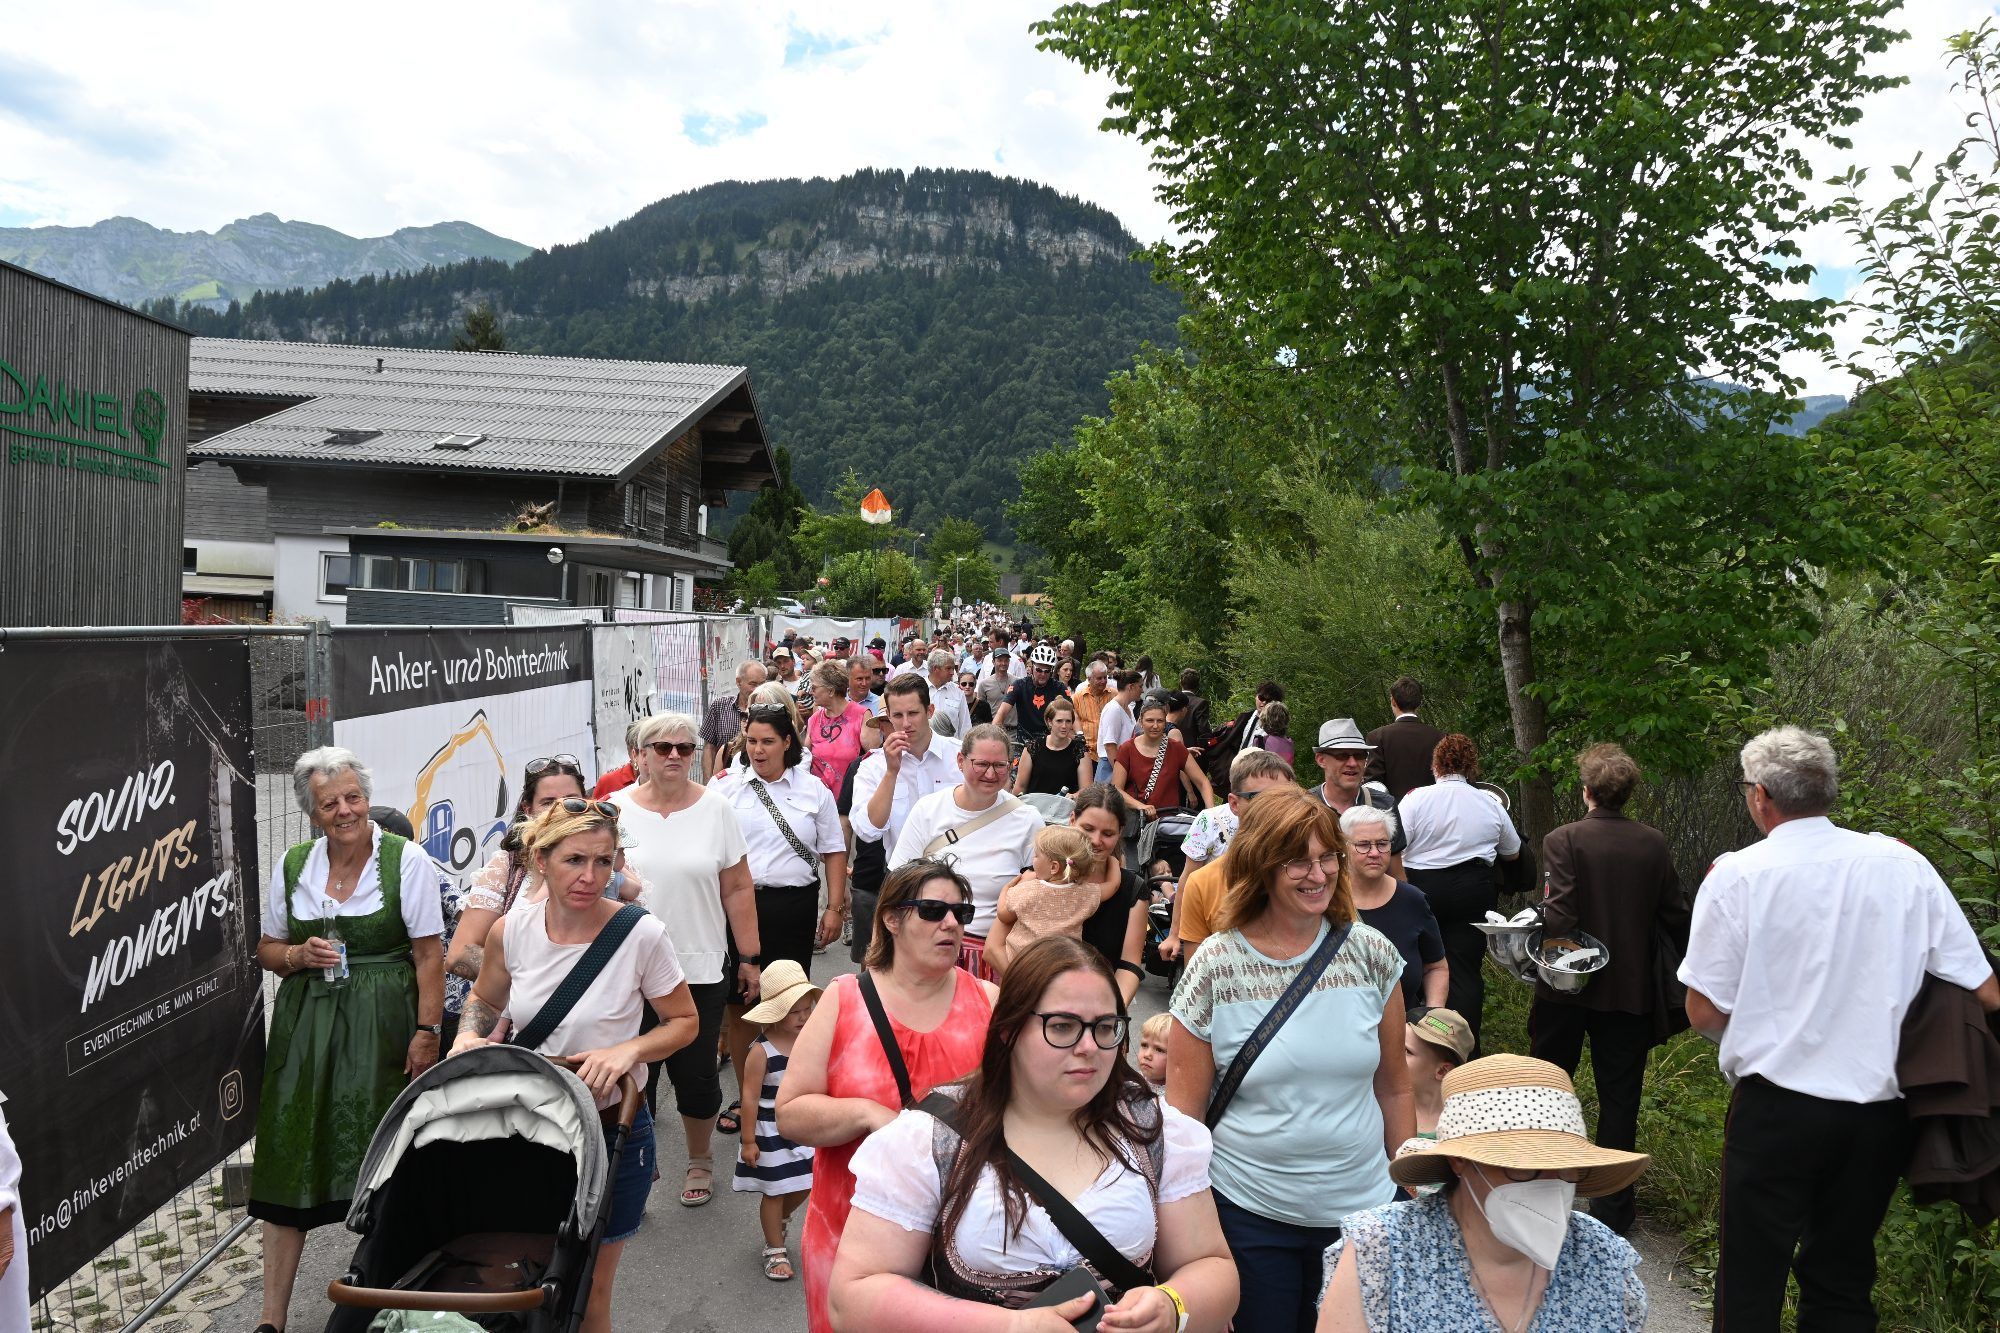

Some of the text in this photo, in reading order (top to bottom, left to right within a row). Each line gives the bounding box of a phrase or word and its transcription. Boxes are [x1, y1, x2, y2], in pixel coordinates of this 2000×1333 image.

[369, 641, 570, 696] Anker- und Bohrtechnik
[56, 759, 176, 856] SOUND.
[68, 819, 198, 938] LIGHTS.
[81, 869, 235, 1014] MOMENTS.
[83, 977, 219, 1057] EVENTTECHNIK DIE MAN FÜHLT.
[1257, 973, 1312, 1041] SKECHERS
[26, 1110, 200, 1246] nfo@finkeventtechnik.at
